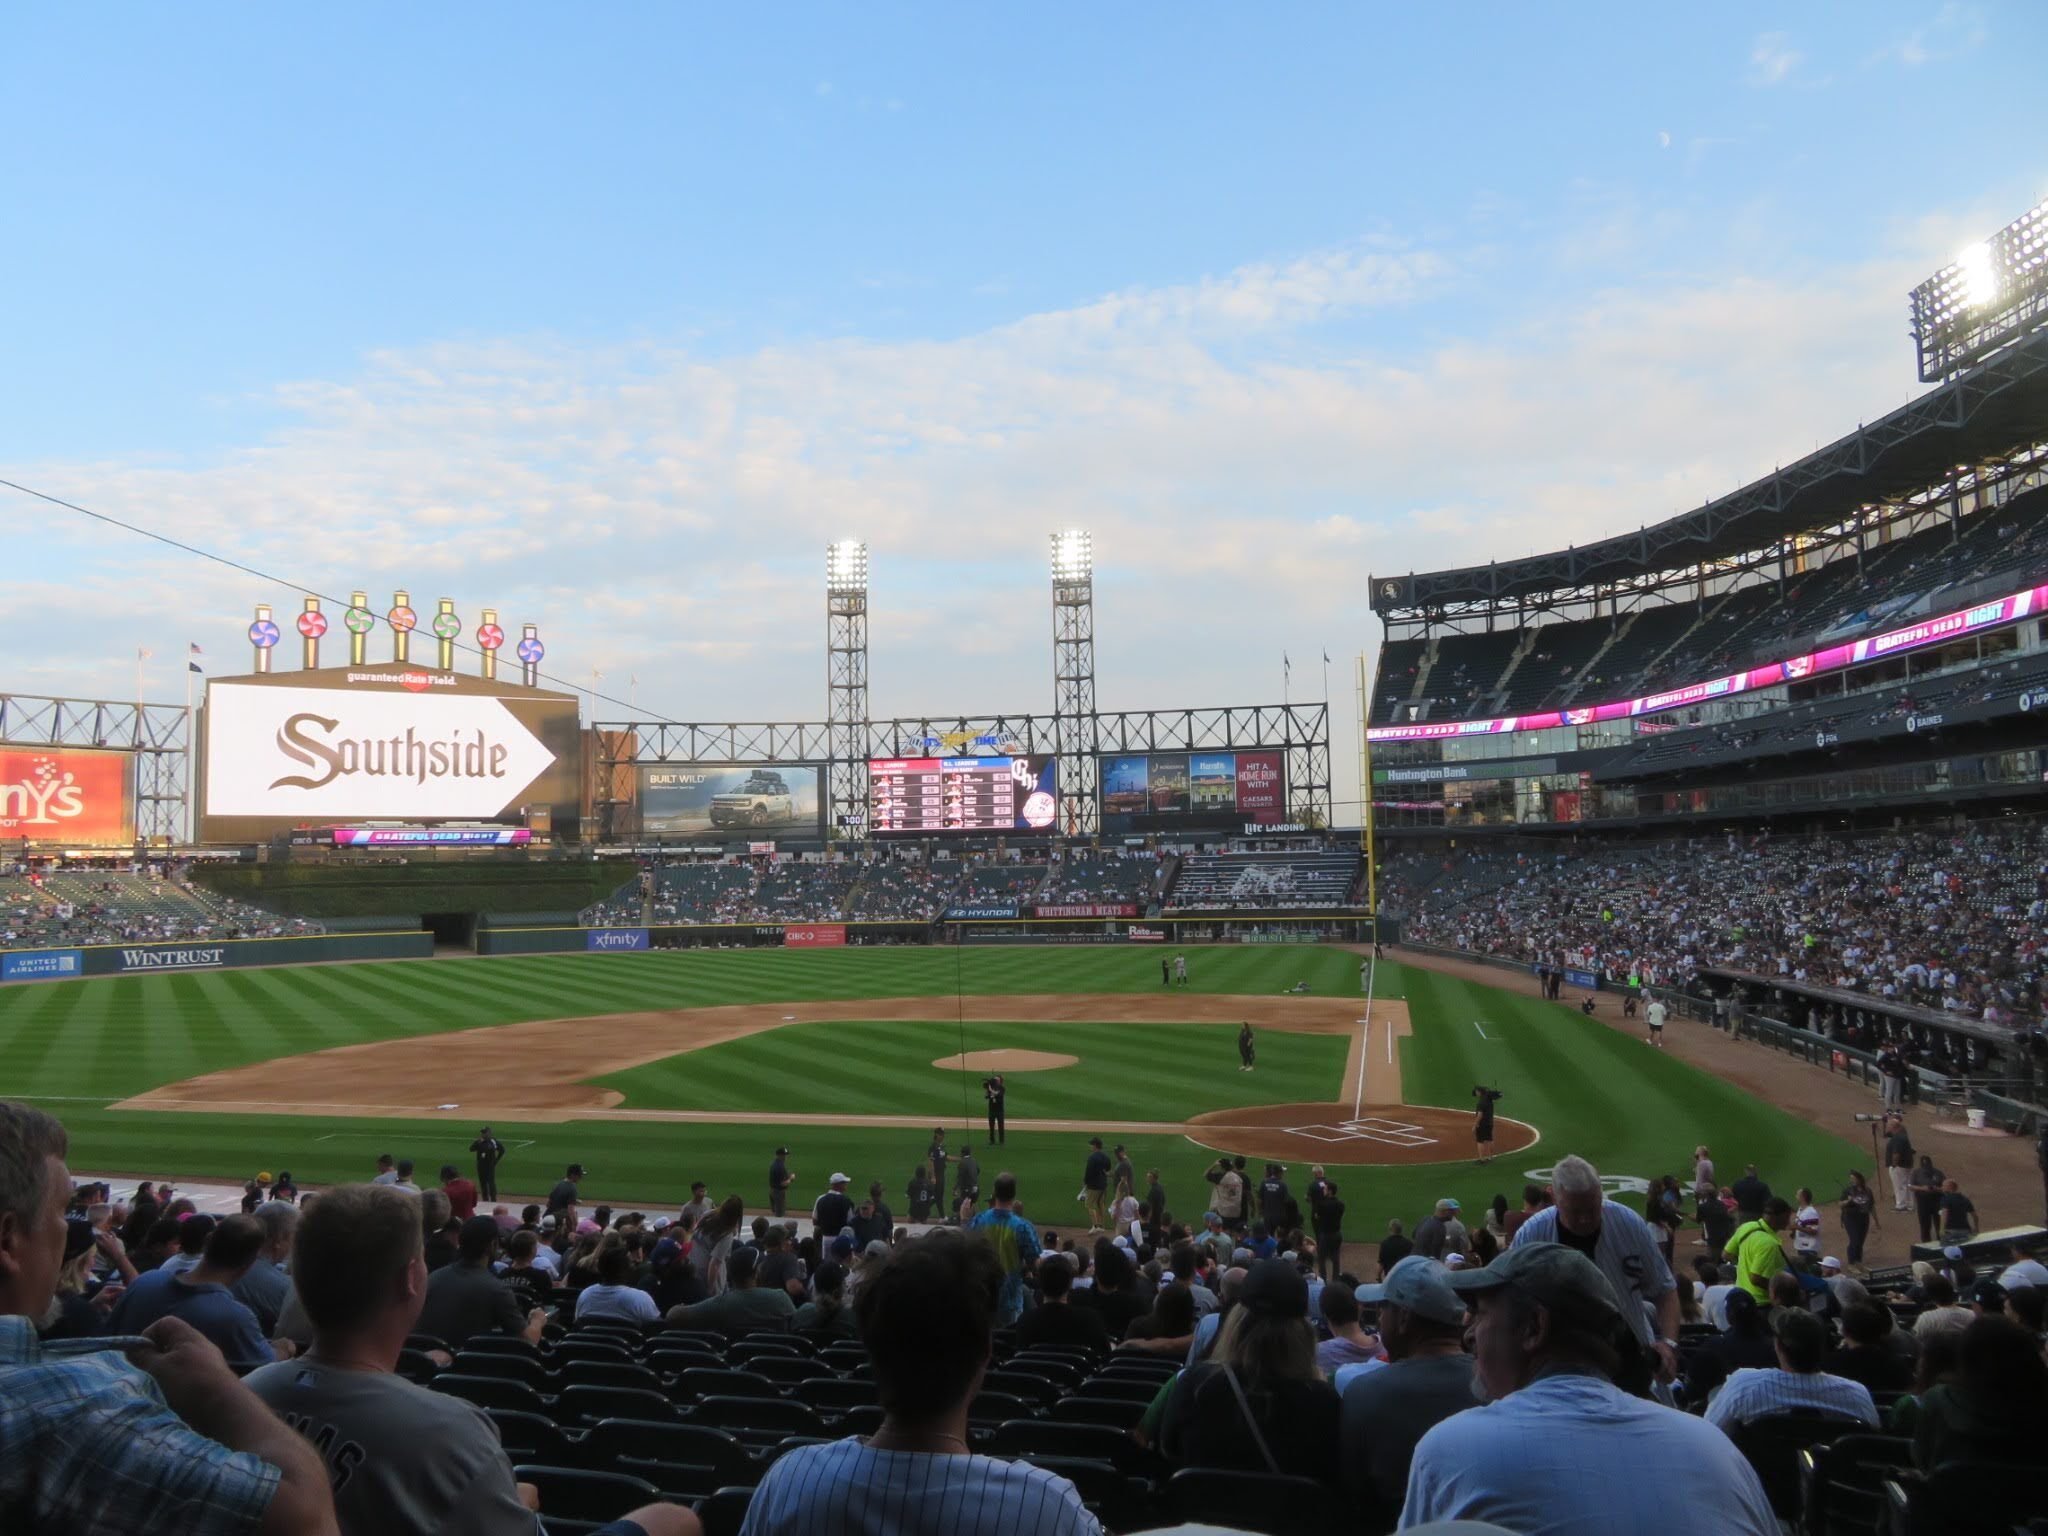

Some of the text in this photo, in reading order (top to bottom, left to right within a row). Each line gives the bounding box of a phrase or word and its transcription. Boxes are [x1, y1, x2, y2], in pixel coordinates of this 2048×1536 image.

[1876, 603, 2005, 652] GRATEFUL DEAD NIGHT
[347, 672, 404, 684] guaranteed
[405, 673, 427, 684] Rate
[1646, 680, 1730, 709] GRATEFUL DEAD NIGHT
[1917, 715, 1943, 727] BAINES
[1366, 722, 1494, 740] GRATEFUL DEAD NIGHT
[976, 736, 997, 745] TIME
[267, 713, 508, 790] Southside
[1246, 763, 1260, 771] HIT
[650, 774, 676, 784] BUILT
[1239, 770, 1277, 781] HOME RUN
[1388, 768, 1442, 782] Huntington
[1444, 766, 1467, 778] Bank
[1247, 780, 1269, 788] WITH
[1244, 823, 1306, 835] Lite LANDING
[376, 832, 494, 842] GRATEFUL DEAD NIGHT
[967, 908, 1014, 918] HYUNDAI
[1037, 904, 1123, 918] WHITTINGHAM MEATS
[755, 927, 774, 935] THE
[1128, 925, 1165, 936] Rate.com
[595, 933, 641, 948] xfinity
[786, 932, 806, 941] CIBC
[19, 958, 57, 967] UNITED
[122, 949, 224, 968] WINTRUST
[9, 965, 57, 974] AIRLINES
